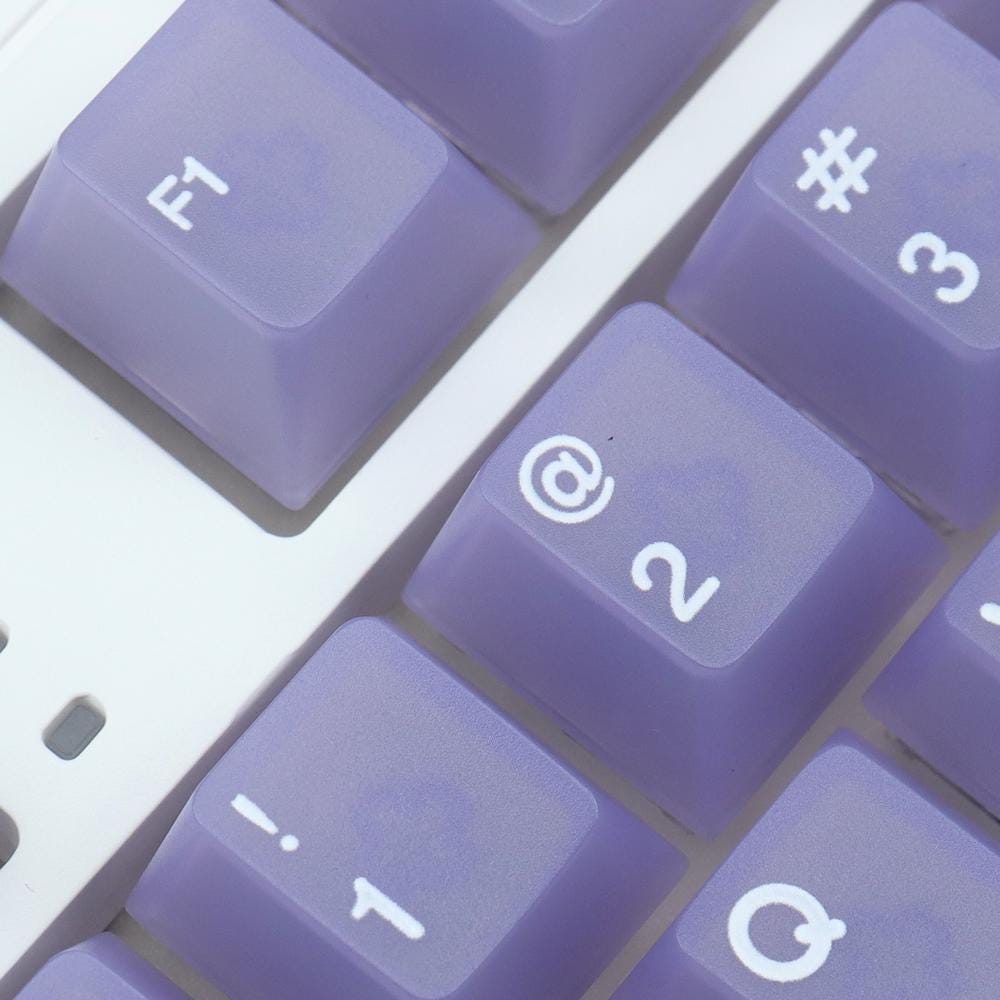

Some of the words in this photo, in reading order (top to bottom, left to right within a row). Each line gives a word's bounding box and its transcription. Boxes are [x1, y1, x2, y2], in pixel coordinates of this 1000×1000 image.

[145, 155, 231, 231] F1
[795, 125, 879, 214] #
[897, 232, 980, 304] 3
[517, 434, 616, 525] @
[630, 541, 721, 623] 2
[349, 876, 426, 940] 1
[726, 882, 847, 983] Q
